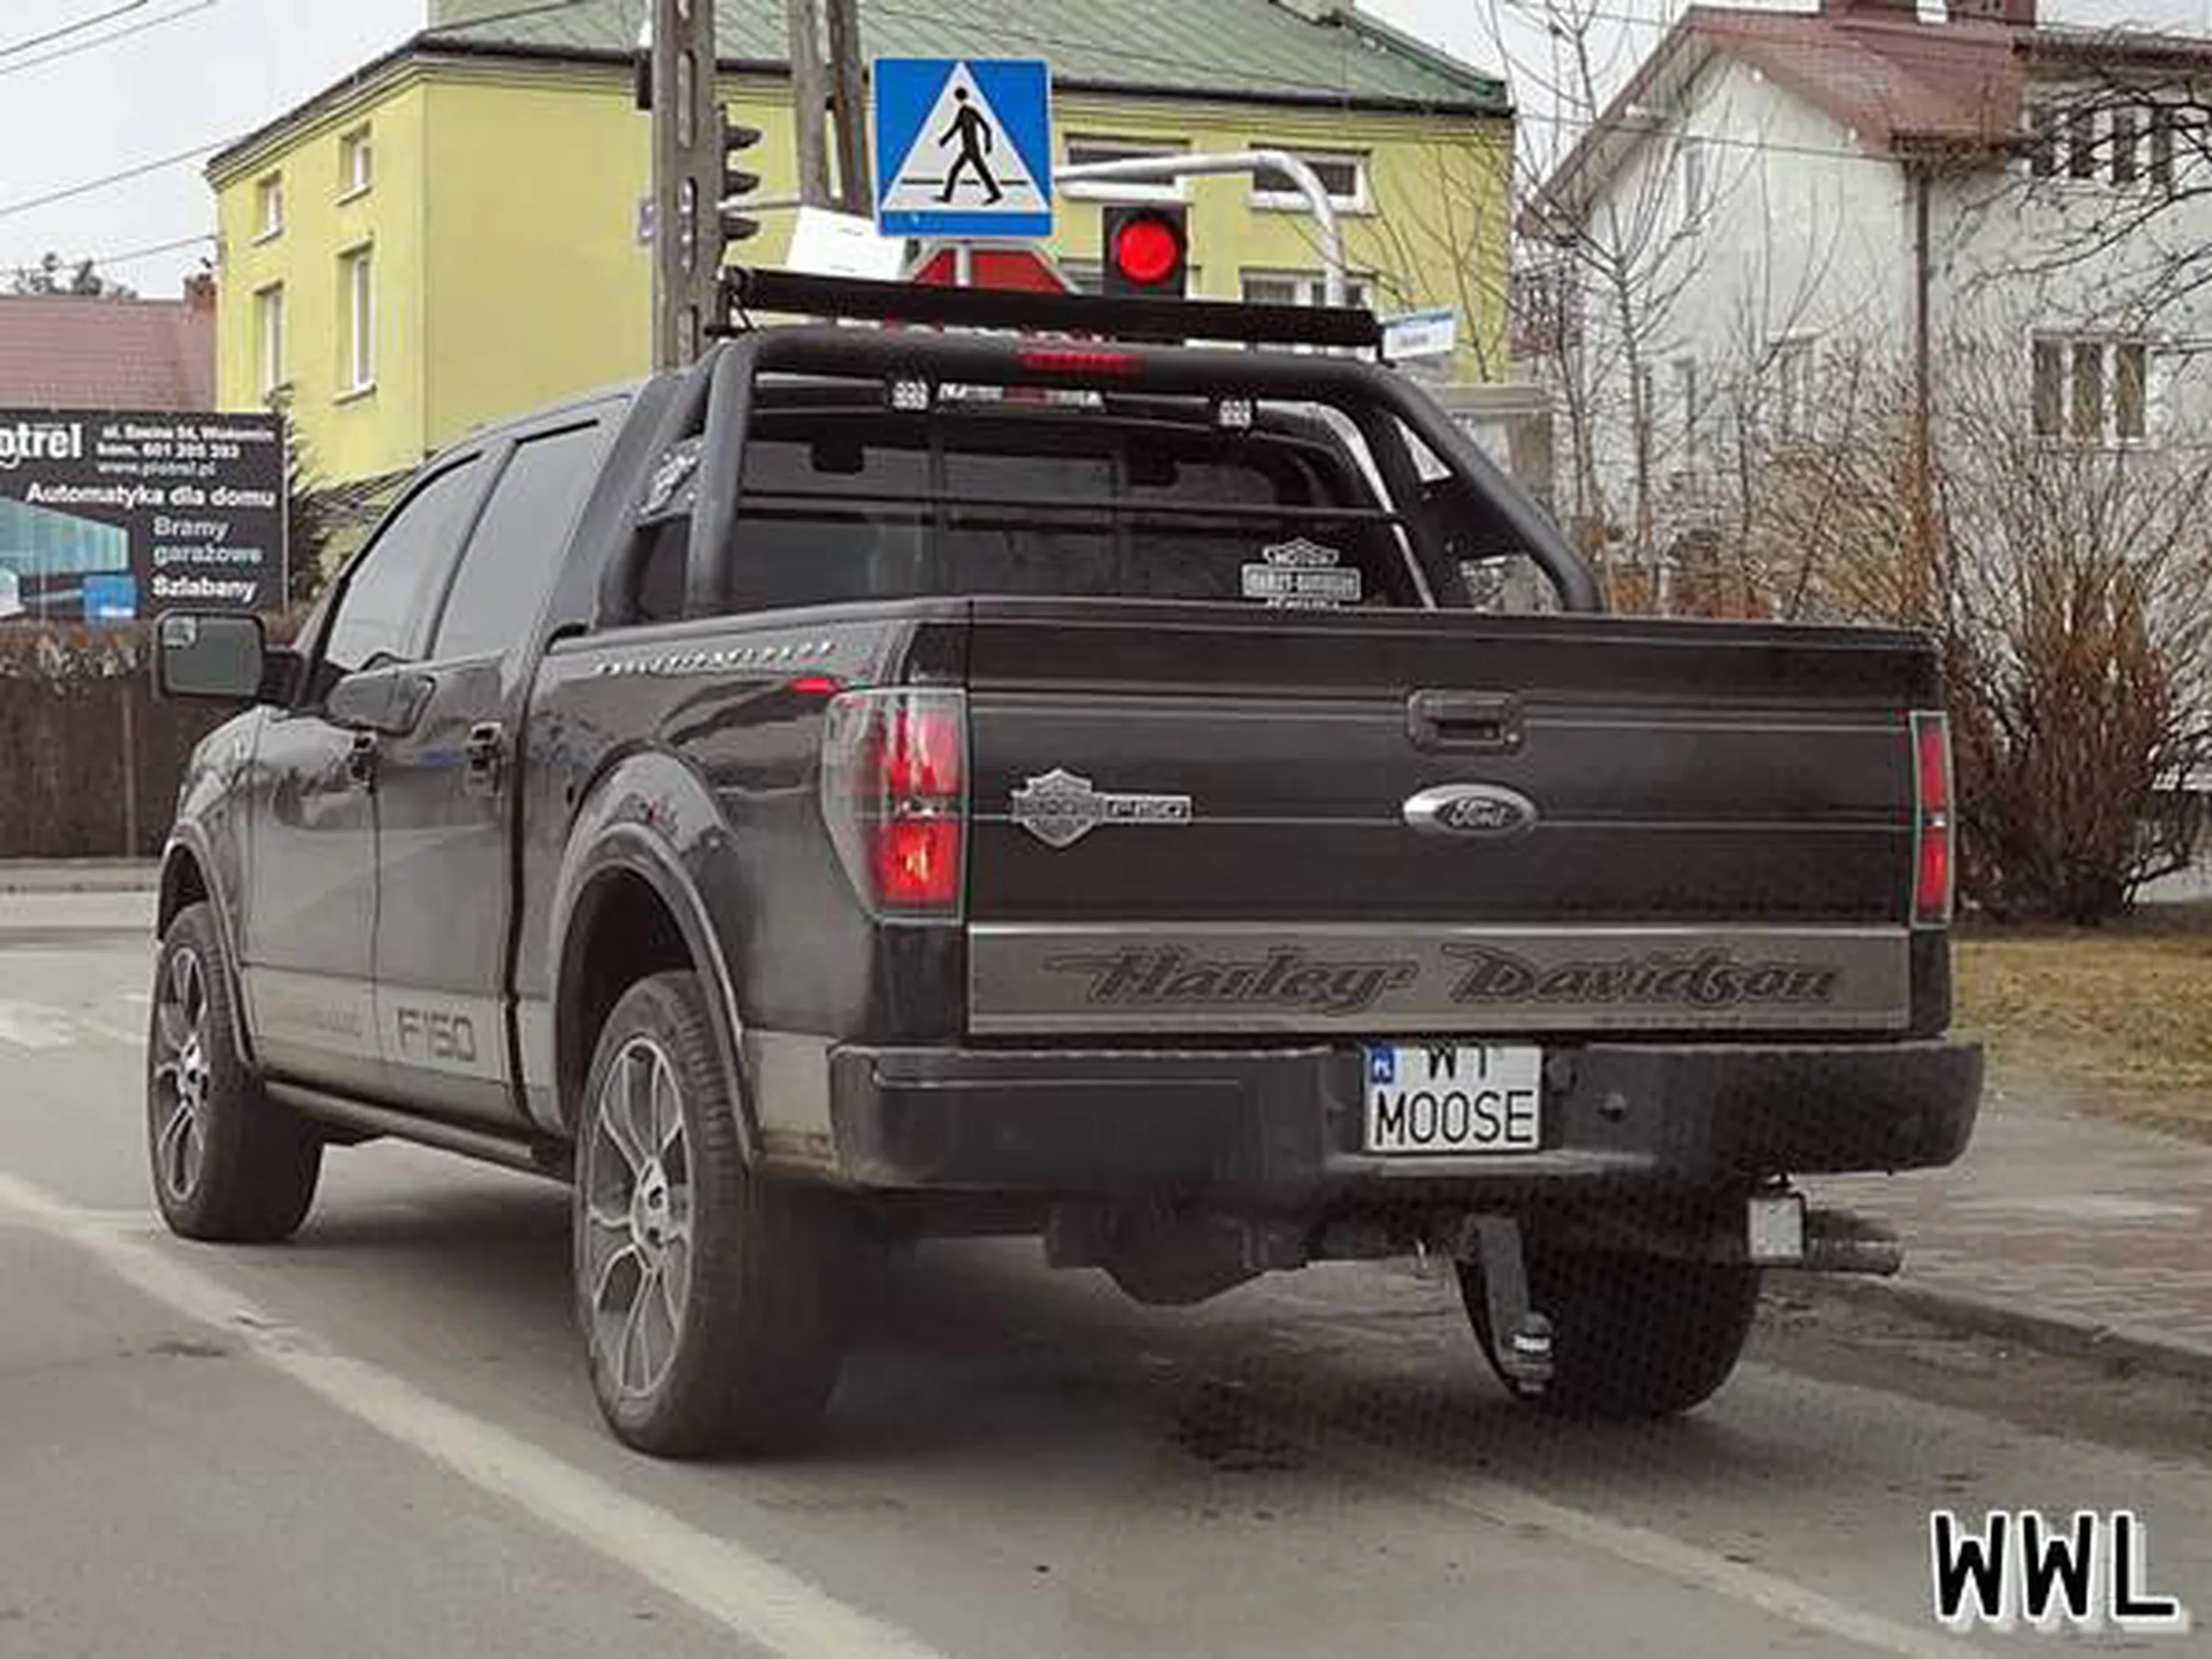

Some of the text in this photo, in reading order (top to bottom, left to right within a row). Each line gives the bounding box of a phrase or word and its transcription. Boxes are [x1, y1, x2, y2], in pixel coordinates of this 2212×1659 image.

[25, 482, 276, 509] Automatyka dla domu
[153, 515, 230, 542] Bramy
[151, 575, 258, 603] Szlabany
[1446, 798, 1508, 827] Ford
[1044, 941, 1840, 1017] Harley Davidson
[1375, 1090, 1533, 1145] MOOSE
